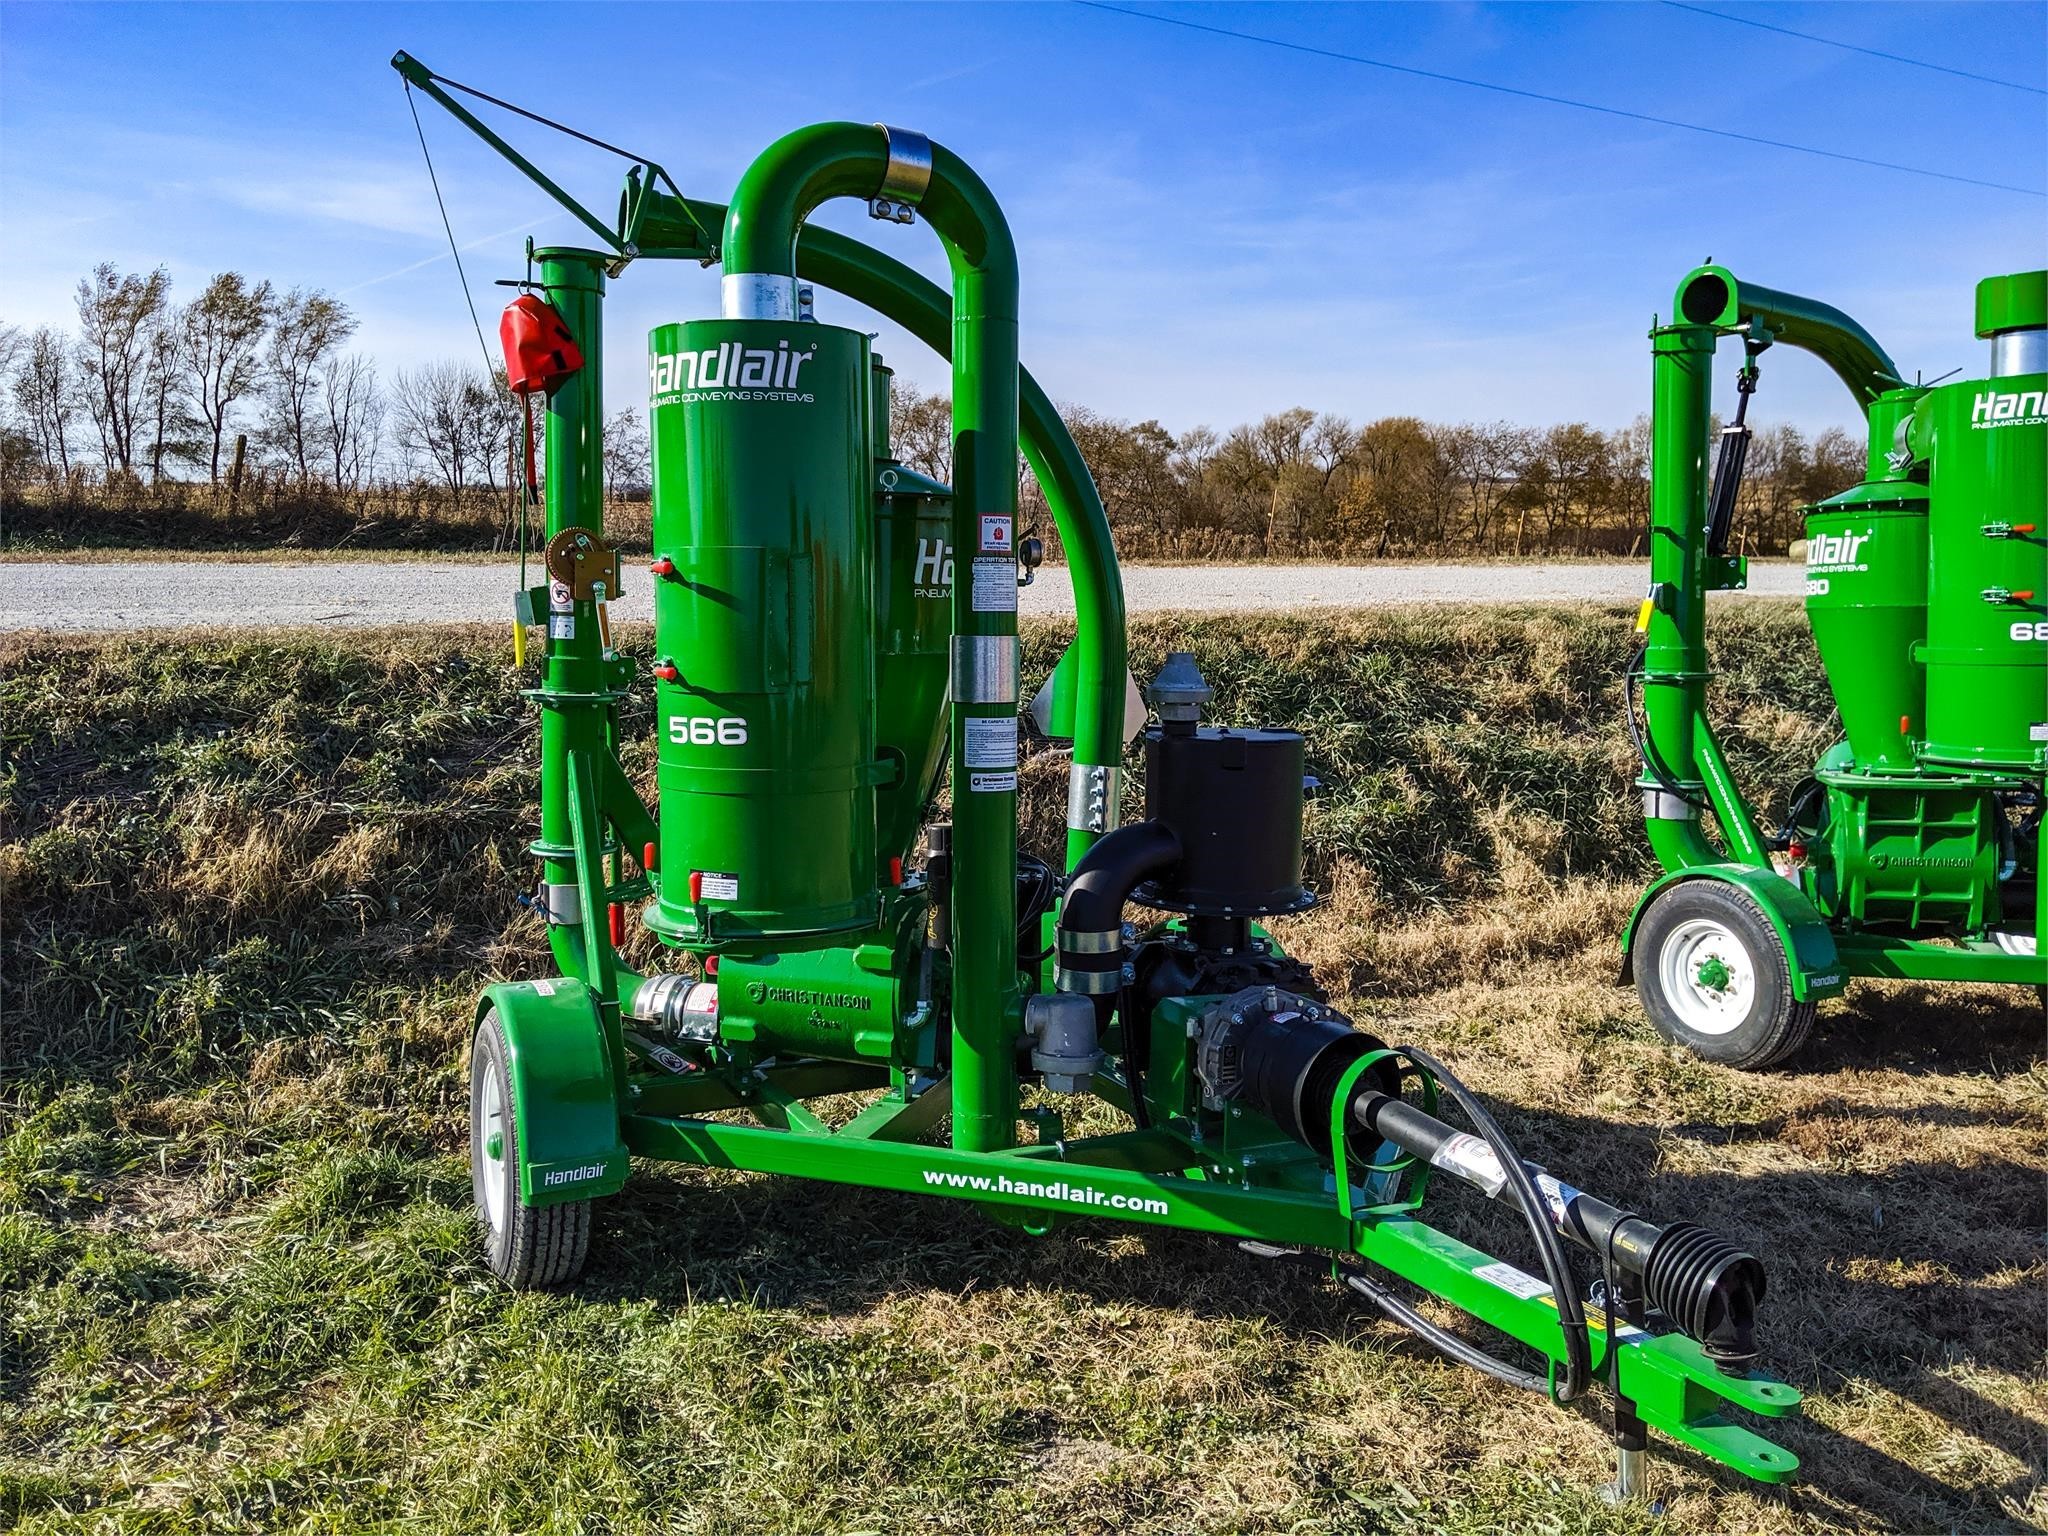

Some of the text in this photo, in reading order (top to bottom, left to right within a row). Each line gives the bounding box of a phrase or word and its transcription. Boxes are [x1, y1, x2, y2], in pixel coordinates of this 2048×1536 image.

[682, 391, 750, 403] CONVEYING
[753, 391, 814, 403] SYSTEMS
[1971, 418, 2023, 430] PNEUMATIC
[984, 517, 1010, 525] CAUTION
[1829, 563, 1868, 573] SYSTEMS
[914, 588, 952, 598] PNEUM
[669, 716, 748, 746] 566
[1890, 856, 1974, 868] CHRISTIANSON
[768, 986, 871, 1011] CHRISTIANSON
[545, 1162, 607, 1186] Handlair
[922, 1170, 1169, 1216] www.handlair.com
